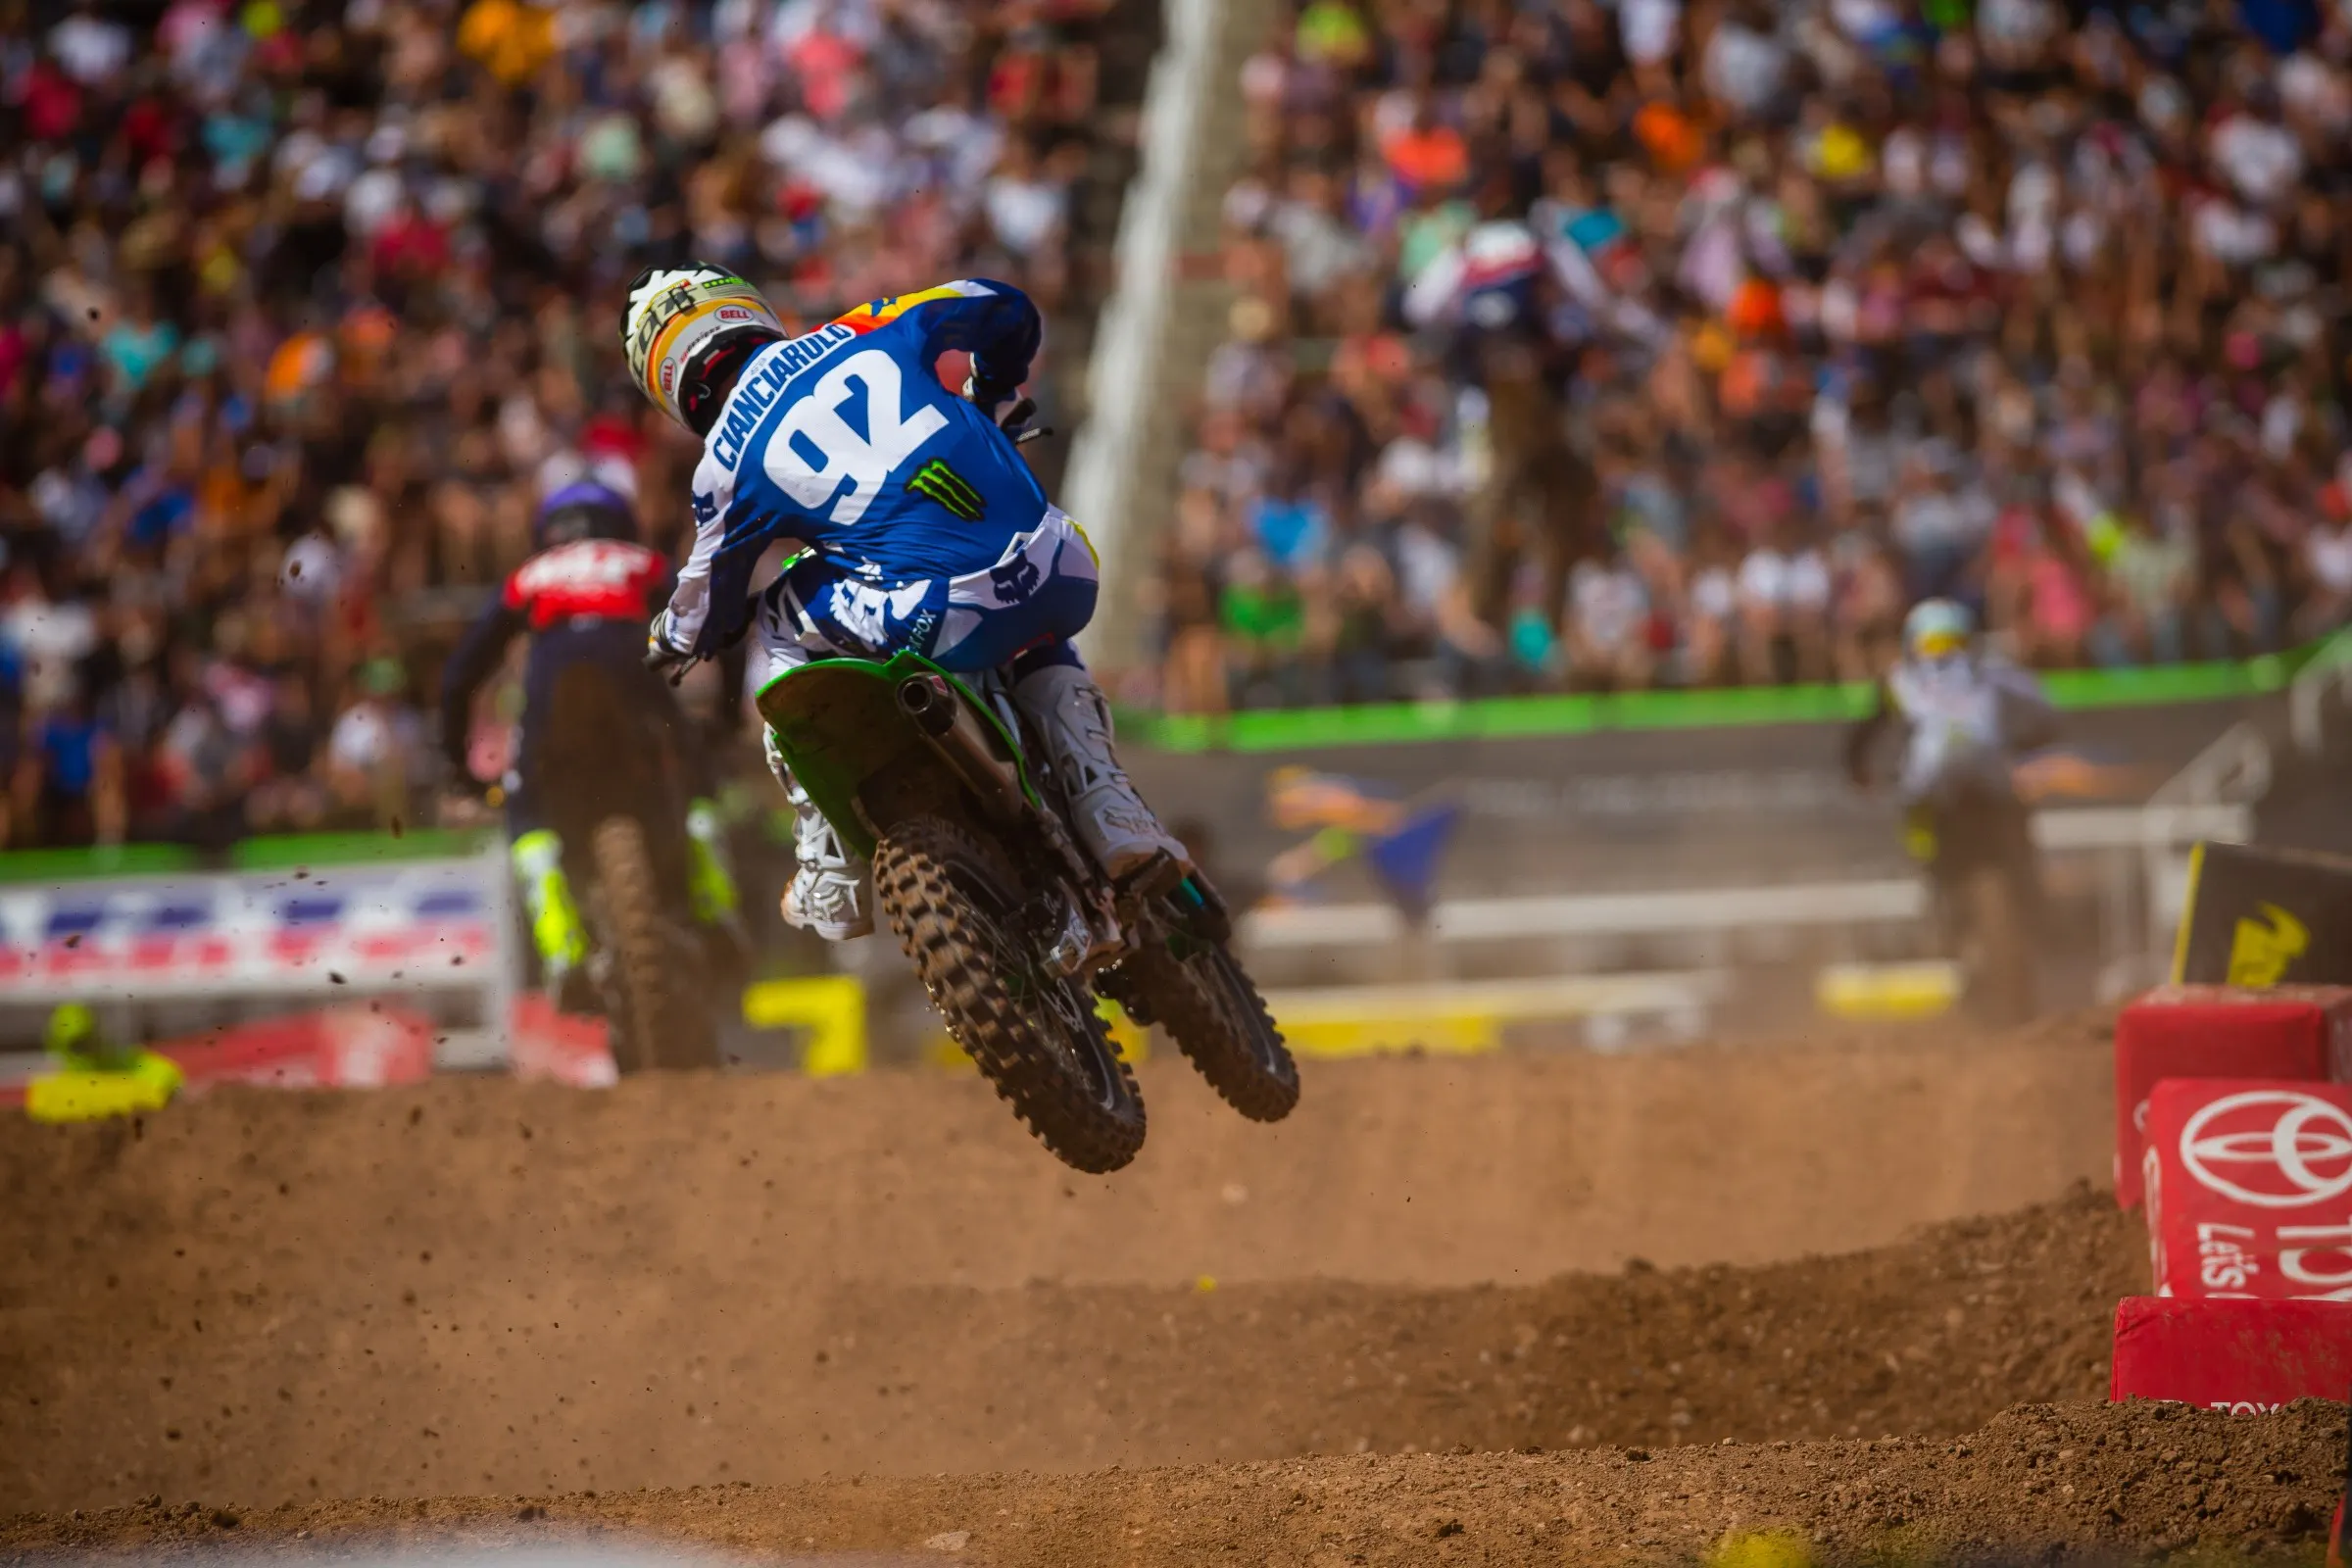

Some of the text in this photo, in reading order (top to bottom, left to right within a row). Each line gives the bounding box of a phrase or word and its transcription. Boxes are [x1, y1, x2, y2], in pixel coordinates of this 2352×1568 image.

[719, 309, 750, 319] BELL
[662, 363, 674, 392] BELL
[712, 323, 855, 472] CIANCIARULO
[762, 349, 950, 526] 92
[911, 608, 937, 642] FOX
